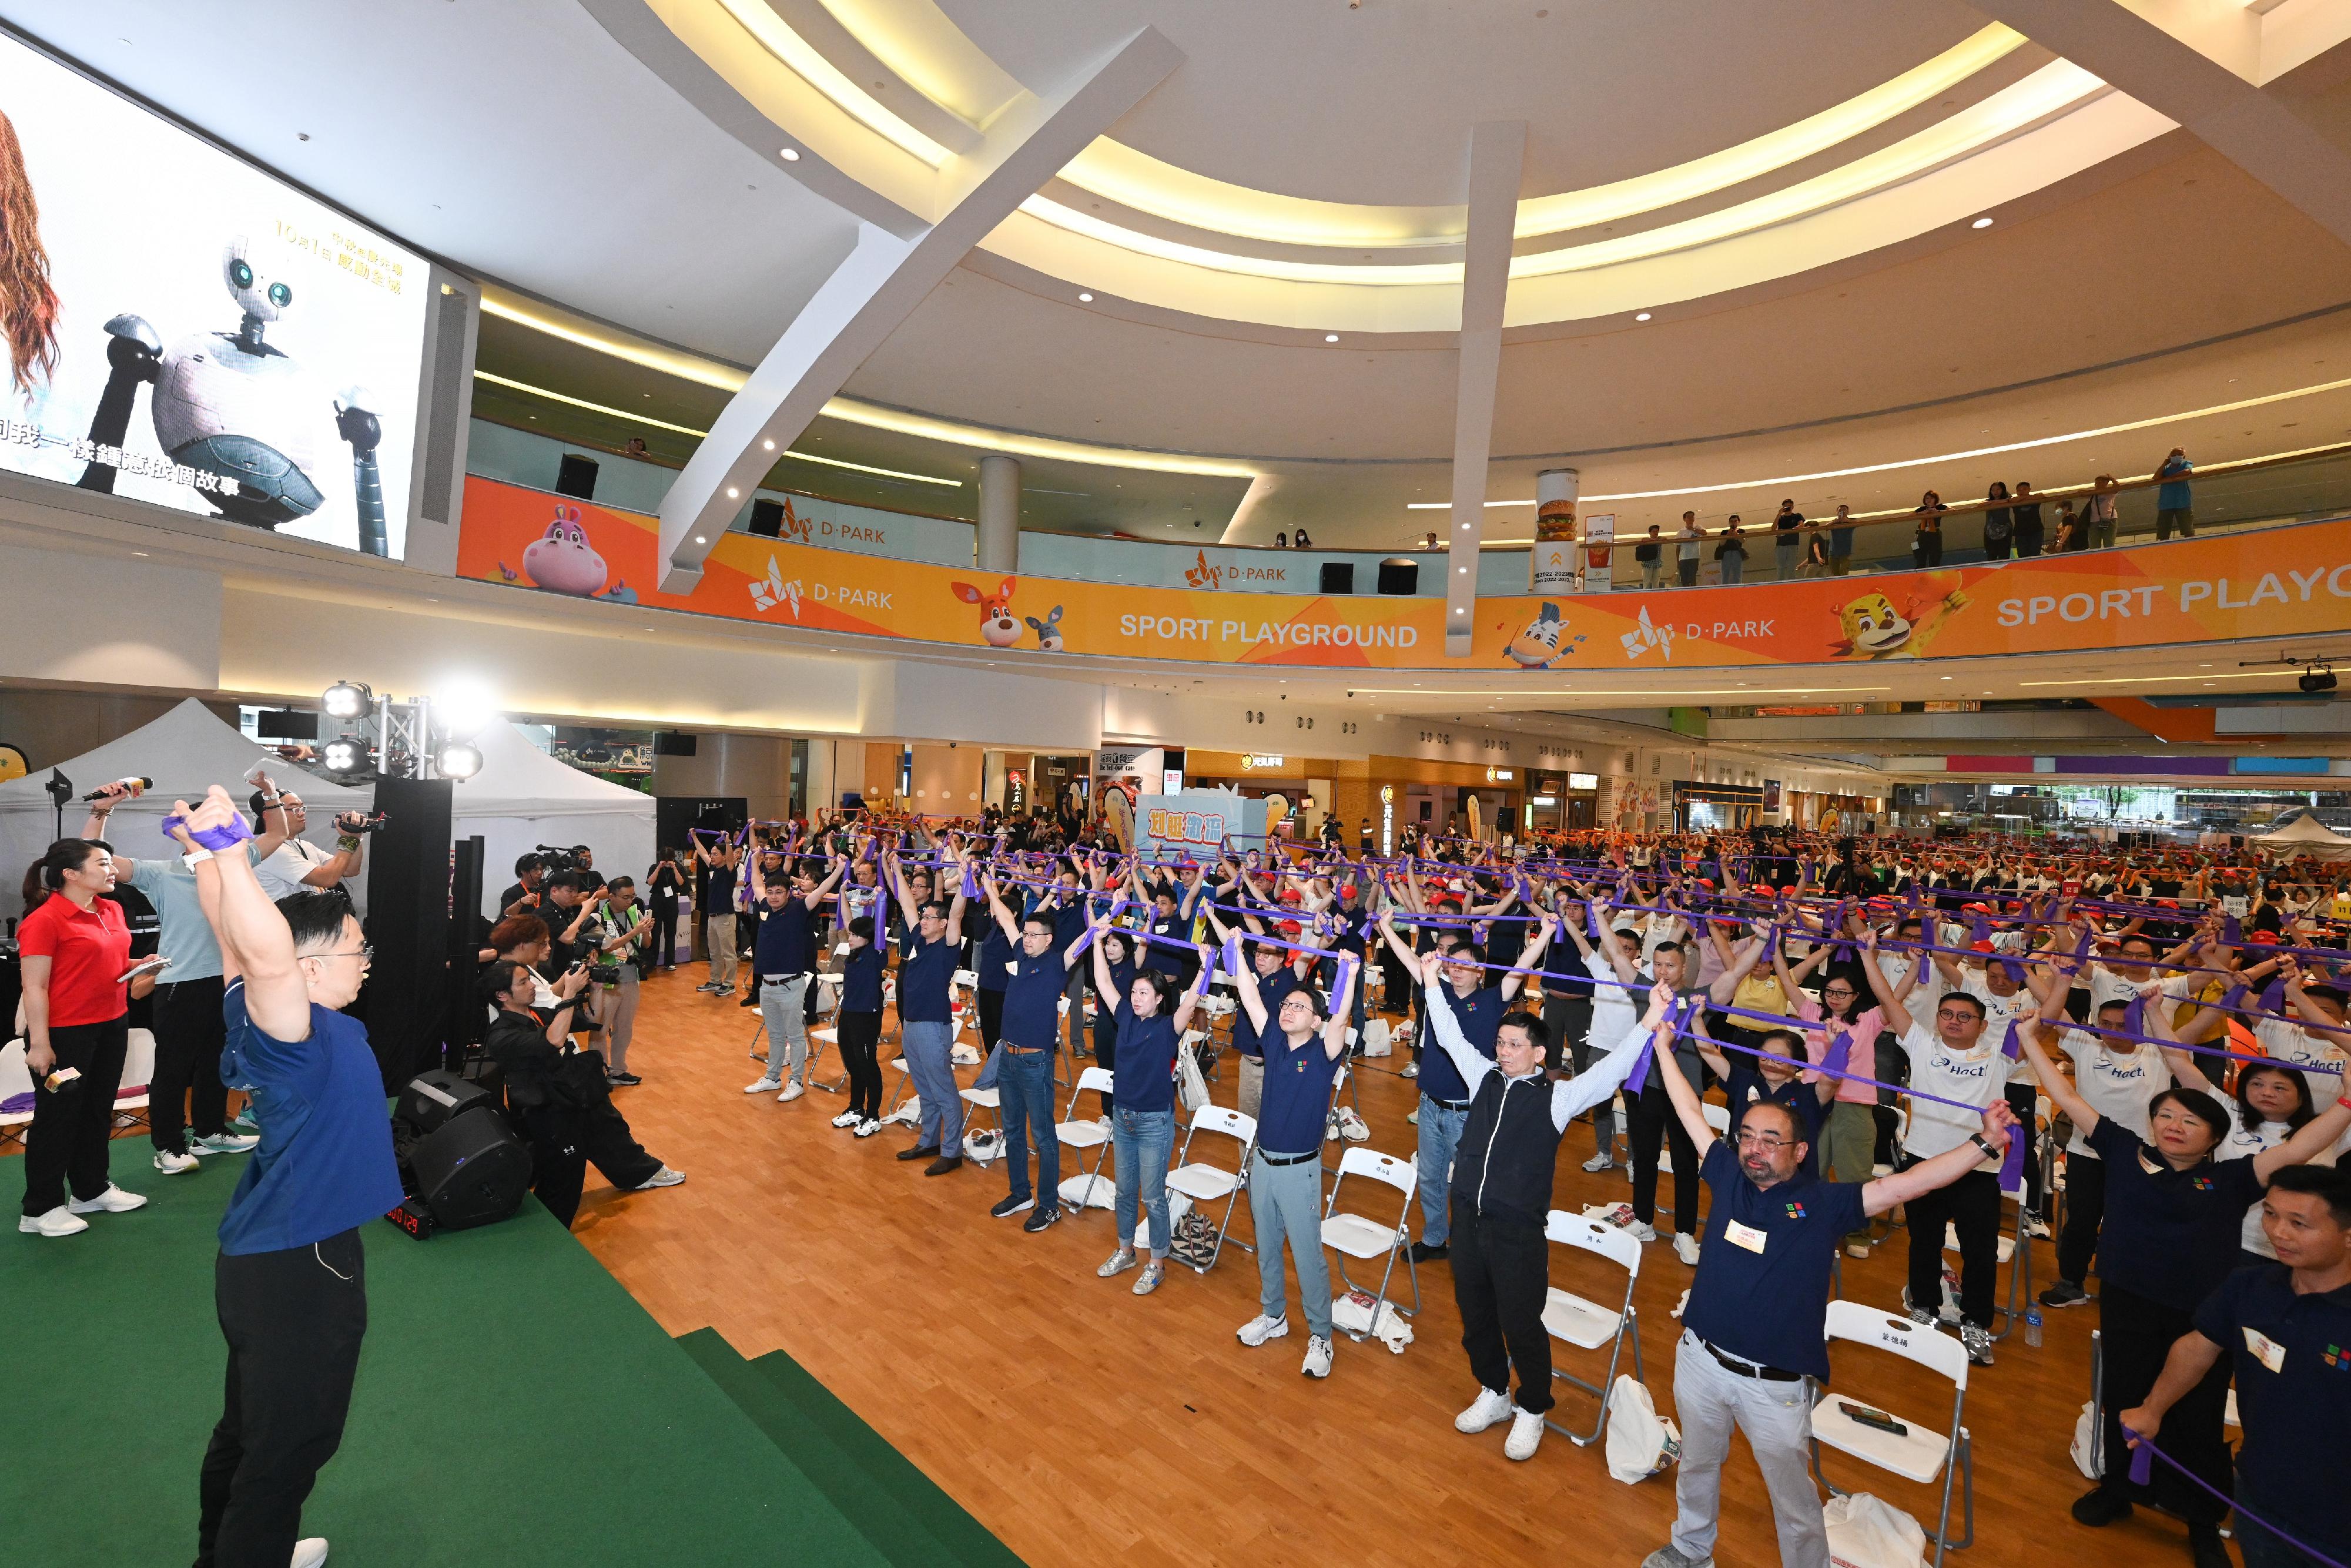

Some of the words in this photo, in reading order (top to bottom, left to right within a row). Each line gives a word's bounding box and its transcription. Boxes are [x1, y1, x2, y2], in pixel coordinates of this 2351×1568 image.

[1997, 585, 2164, 626] SPORT
[1120, 614, 1213, 640] SPORT
[1221, 621, 1417, 648] PLAYGROUND
[1150, 812, 1222, 842] 划艇激流
[1882, 1332, 1908, 1348] 蒙德揚
